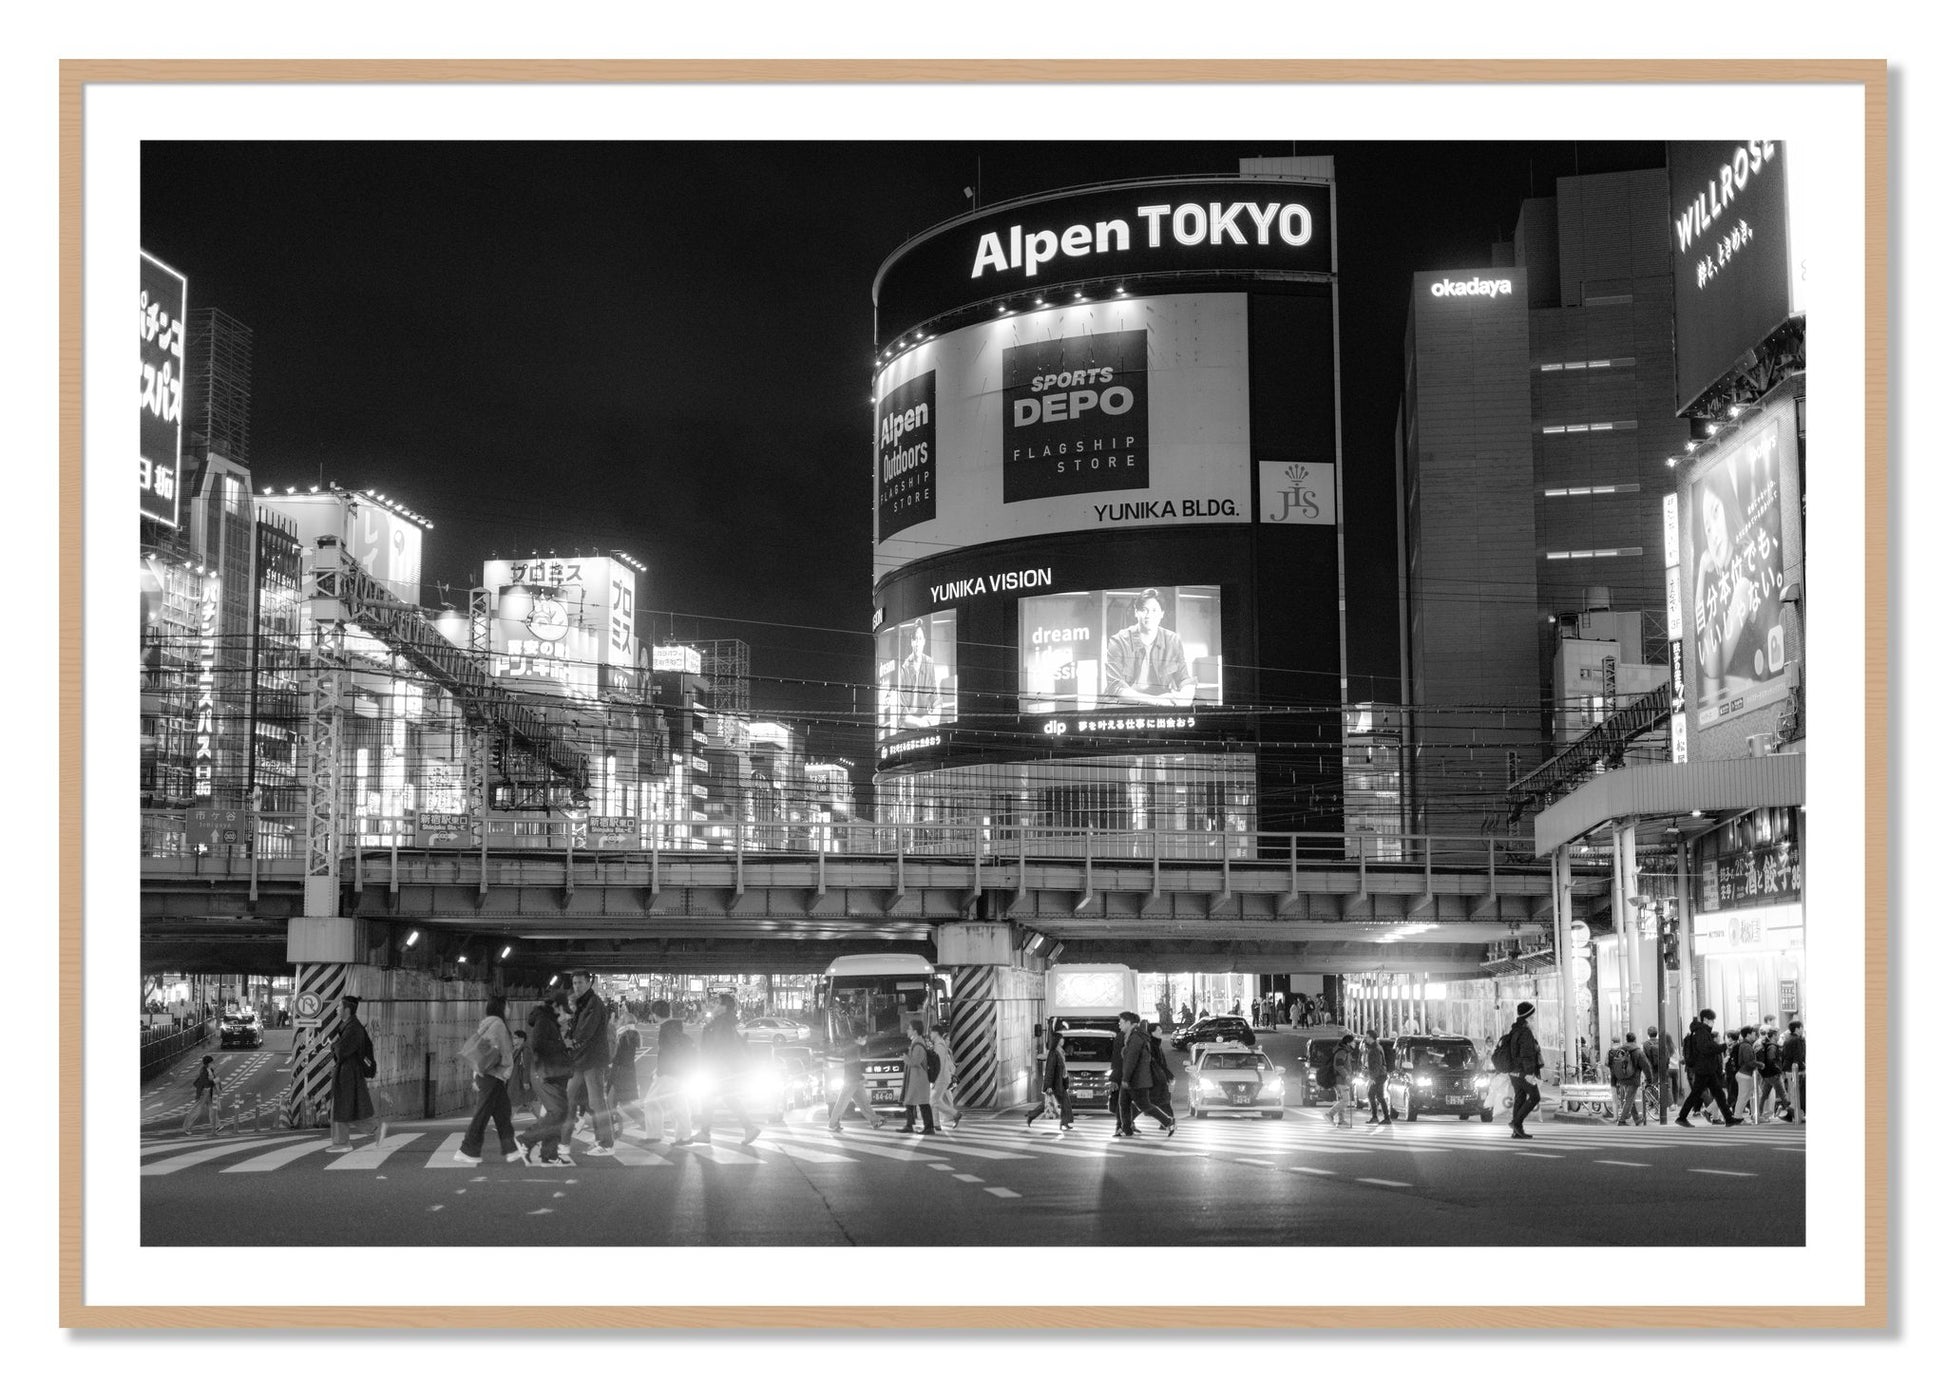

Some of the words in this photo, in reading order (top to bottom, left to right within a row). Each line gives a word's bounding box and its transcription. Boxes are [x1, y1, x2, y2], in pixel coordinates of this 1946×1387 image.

[971, 217, 1130, 279] Alpen
[1137, 202, 1313, 248] TOKYO
[1430, 277, 1513, 299] okadaya
[1031, 366, 1114, 393] SPORTS
[1013, 385, 1135, 429] DEPO
[880, 402, 929, 450] Alpen
[883, 439, 929, 484] Outdoors
[1013, 435, 1135, 462] FLAGSHIP
[1057, 454, 1136, 474] STORE
[893, 487, 930, 513] STORE
[1093, 500, 1177, 522] YUNIKA
[1181, 498, 1241, 518] BLDG.
[265, 568, 297, 589] SHISHA
[511, 561, 583, 583] プロミス
[929, 577, 987, 603] YUNIKA
[989, 567, 1053, 592] VISION
[1032, 626, 1090, 644] dream
[1043, 720, 1067, 736] dip
